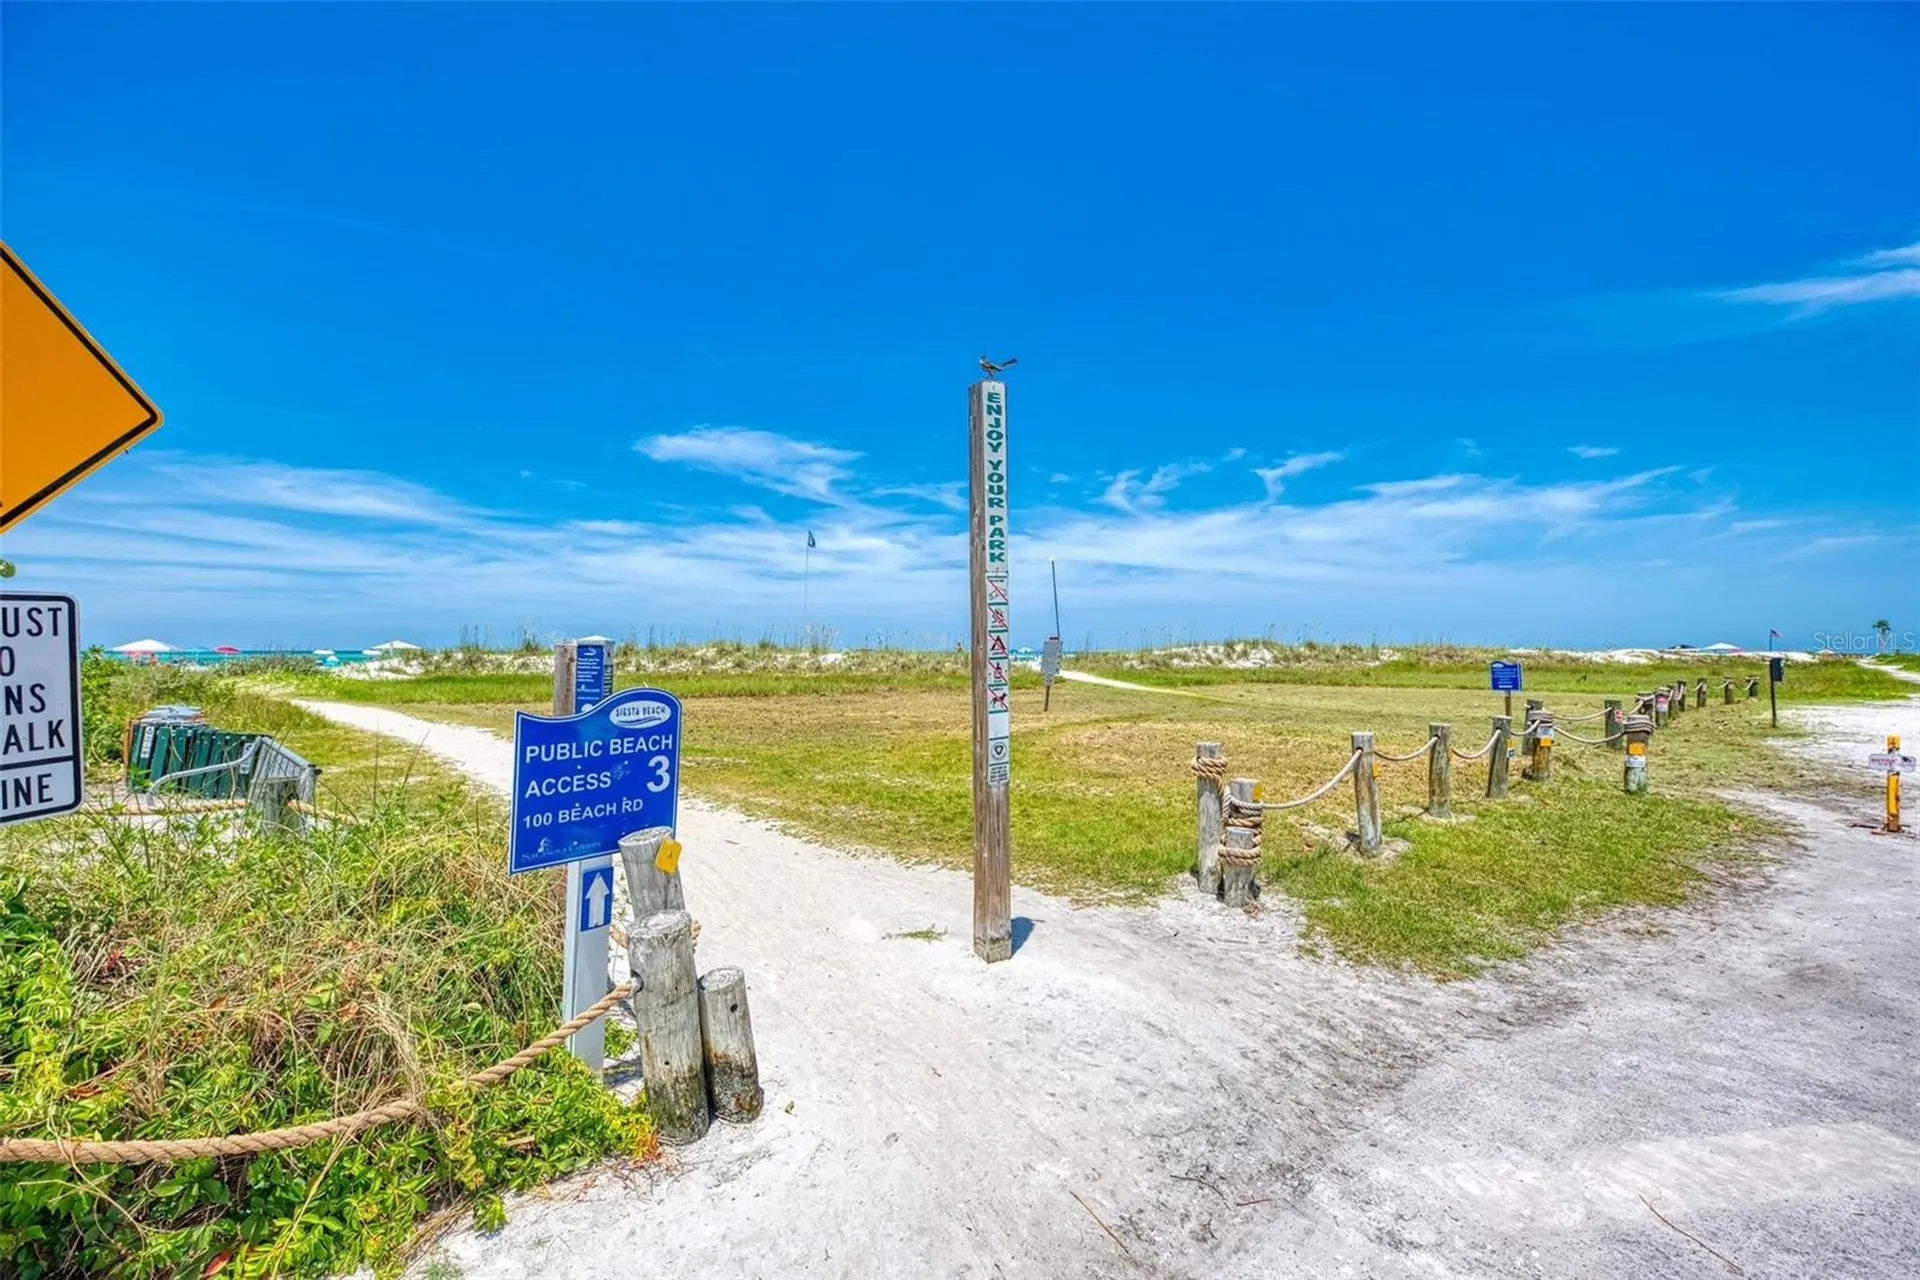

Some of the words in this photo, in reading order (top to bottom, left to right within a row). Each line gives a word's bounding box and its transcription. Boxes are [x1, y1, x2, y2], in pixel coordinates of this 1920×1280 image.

[986, 391, 1004, 453] ENJOY
[987, 459, 1005, 509] YOUR
[988, 515, 1005, 563] PARK
[1, 606, 63, 638] UST
[0, 645, 16, 677] O
[4, 682, 46, 716] NS
[615, 706, 640, 718] SIESTA
[642, 705, 666, 716] BEACH
[2, 718, 66, 756] ALK
[525, 740, 603, 764] PUBLIC
[609, 733, 674, 756] BEACH
[524, 771, 612, 799] ACCESS
[646, 754, 672, 793] 3
[1, 772, 54, 810] INE
[522, 812, 553, 829] 100
[558, 803, 617, 824] BEACH
[621, 798, 644, 813] RD
